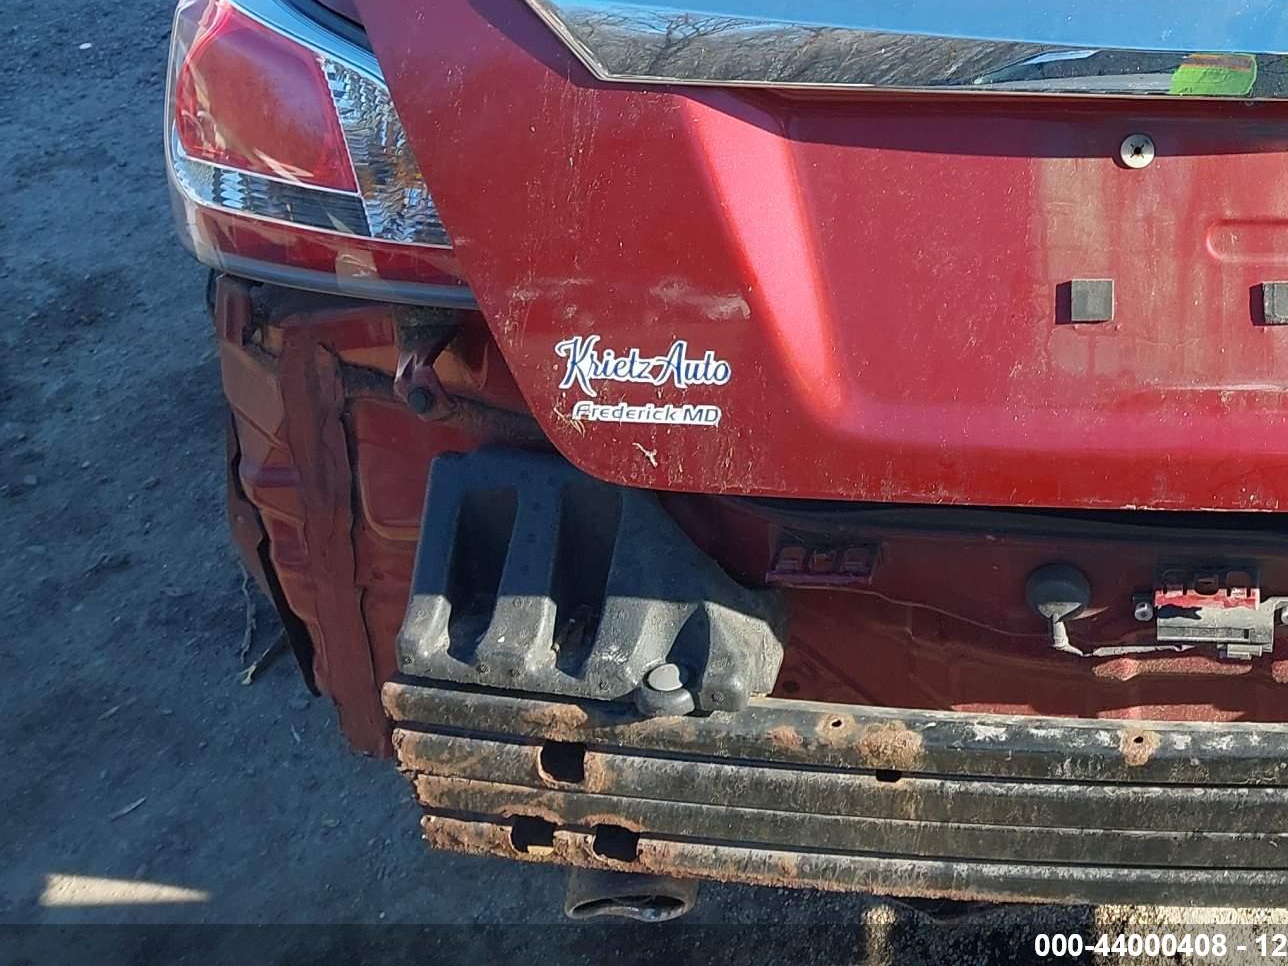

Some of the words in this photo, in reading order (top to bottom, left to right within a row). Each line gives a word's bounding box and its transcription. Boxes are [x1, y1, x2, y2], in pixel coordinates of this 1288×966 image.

[555, 336, 652, 397] Krietz
[652, 341, 732, 387] Auto
[575, 403, 676, 422] Frederick
[682, 408, 719, 424] MD
